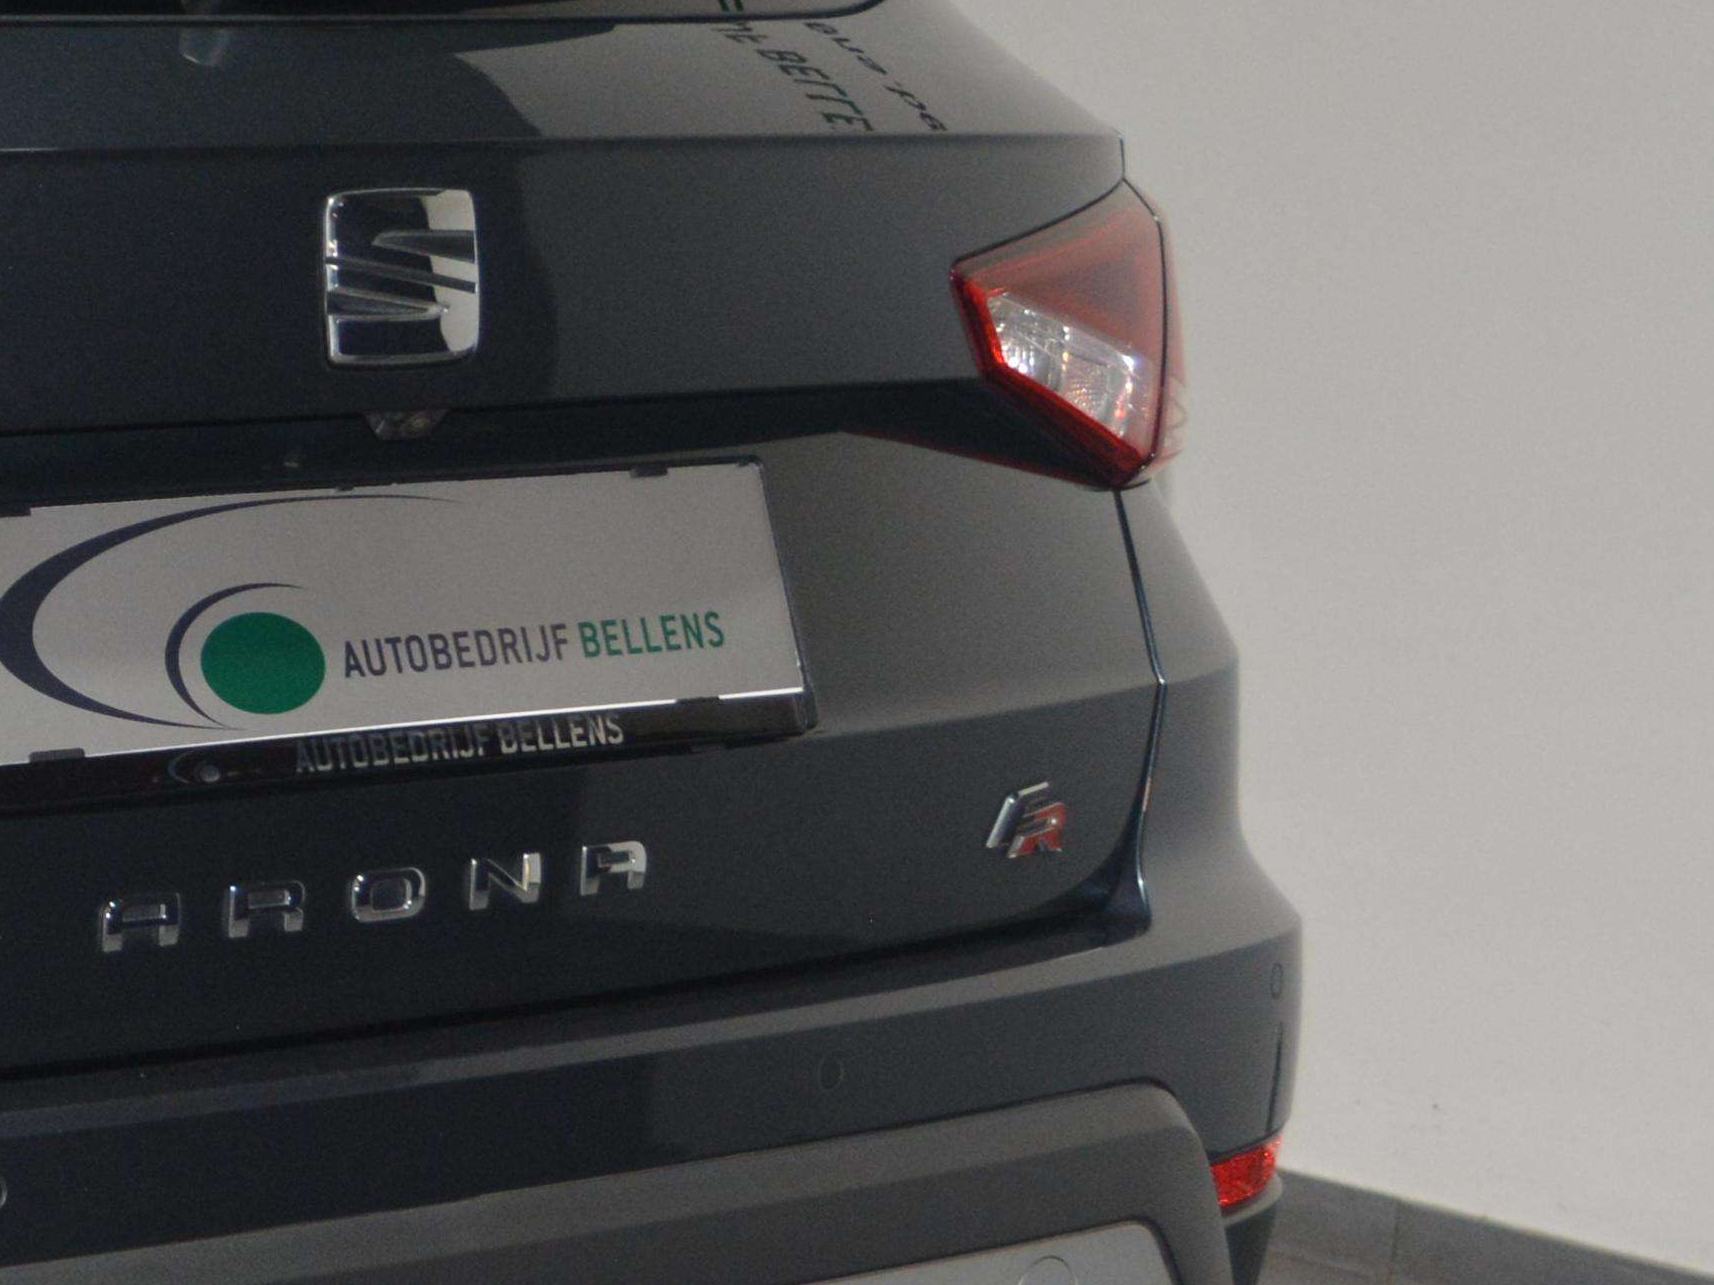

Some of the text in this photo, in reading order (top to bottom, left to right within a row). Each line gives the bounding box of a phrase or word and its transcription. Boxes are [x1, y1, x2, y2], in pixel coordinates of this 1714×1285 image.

[343, 611, 726, 679] AUTOBEDRIJF BELLENS
[295, 715, 625, 774] AUTOBEDRIJF BELLENS
[101, 840, 647, 953] ARONA
